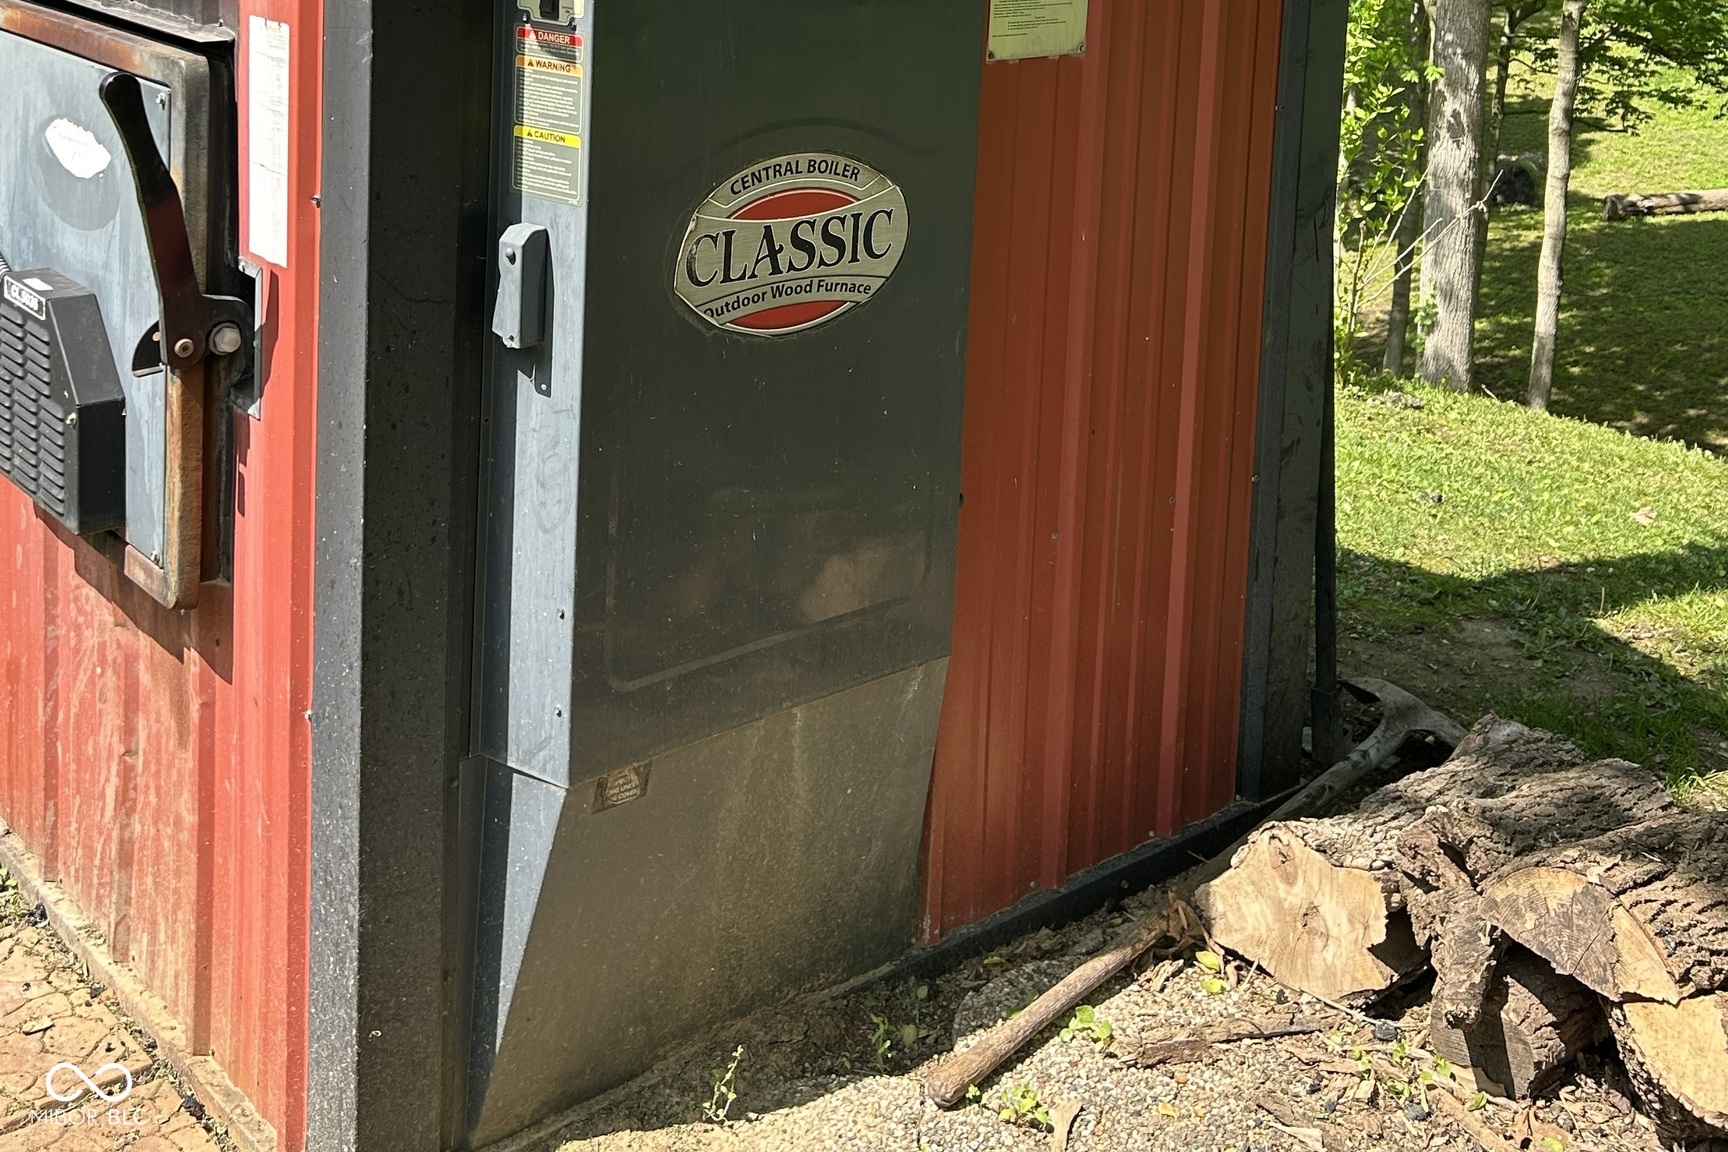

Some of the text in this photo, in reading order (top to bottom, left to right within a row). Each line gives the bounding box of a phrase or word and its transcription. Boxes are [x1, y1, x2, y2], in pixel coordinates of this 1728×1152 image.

[538, 31, 571, 45] DANGER
[536, 59, 571, 73] WARNING
[534, 130, 566, 143] CAUTION
[730, 159, 861, 196] CENTRAL BOILER
[685, 208, 894, 288] CLASSIC
[703, 279, 872, 319] Outdoor Wood Furnace
